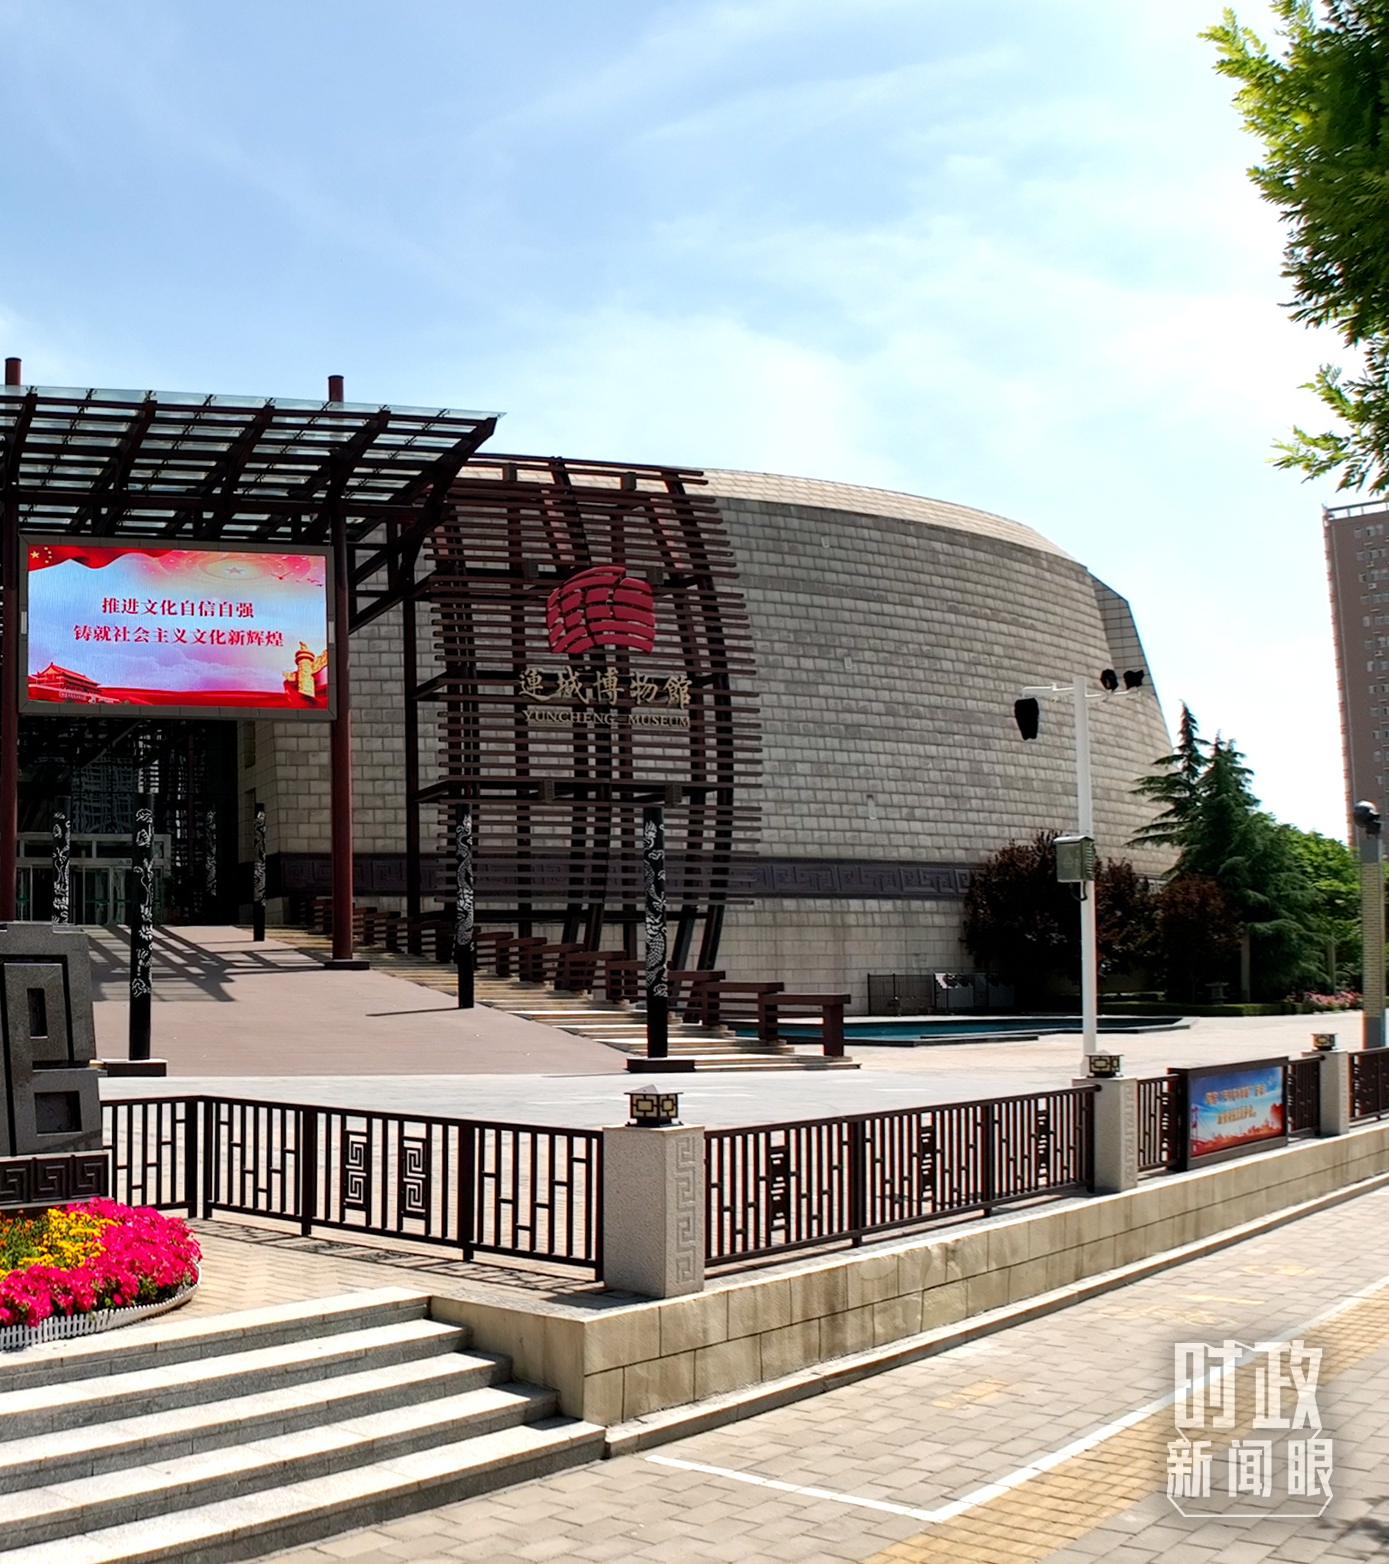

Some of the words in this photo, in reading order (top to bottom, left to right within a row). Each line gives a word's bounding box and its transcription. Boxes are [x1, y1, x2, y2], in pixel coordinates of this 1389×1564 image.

[101, 597, 255, 619] 推进文化自信自强
[73, 624, 284, 647] 铸就社会主义文化新辉煌
[522, 710, 614, 725] YUNCHENG
[628, 713, 690, 727] MUSEUM
